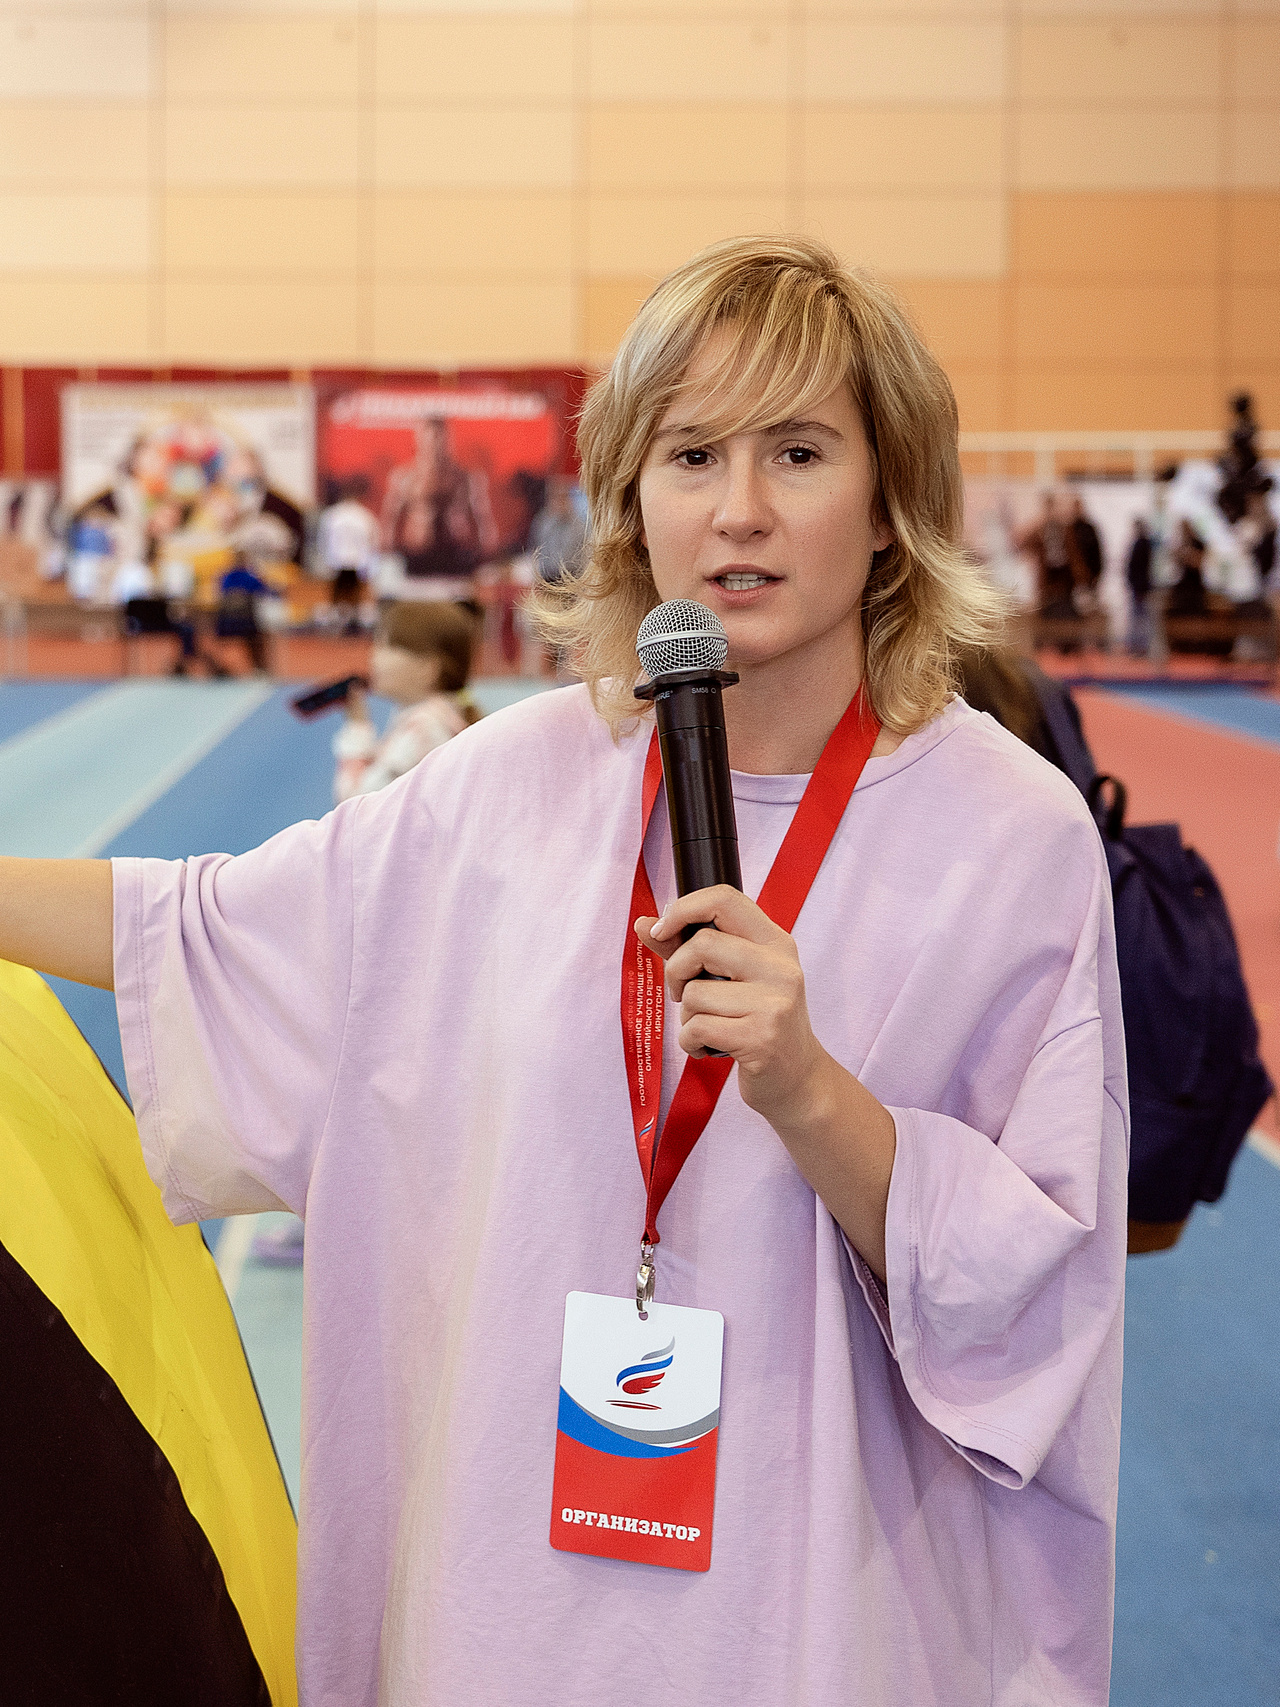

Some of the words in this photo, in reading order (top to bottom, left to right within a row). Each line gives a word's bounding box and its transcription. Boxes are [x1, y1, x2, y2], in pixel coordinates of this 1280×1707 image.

[627, 970, 634, 980] РФ
[636, 972, 644, 1016] УЧИЛИЩЕ
[645, 958, 654, 996] РЕЗЕРВА
[643, 998, 653, 1072] ОЛИМПИЙСКОГО
[635, 1017, 646, 1106] ГОСУДАРСТВЕННОЕ
[561, 1507, 701, 1542] ОРГАНИЗАТОР
